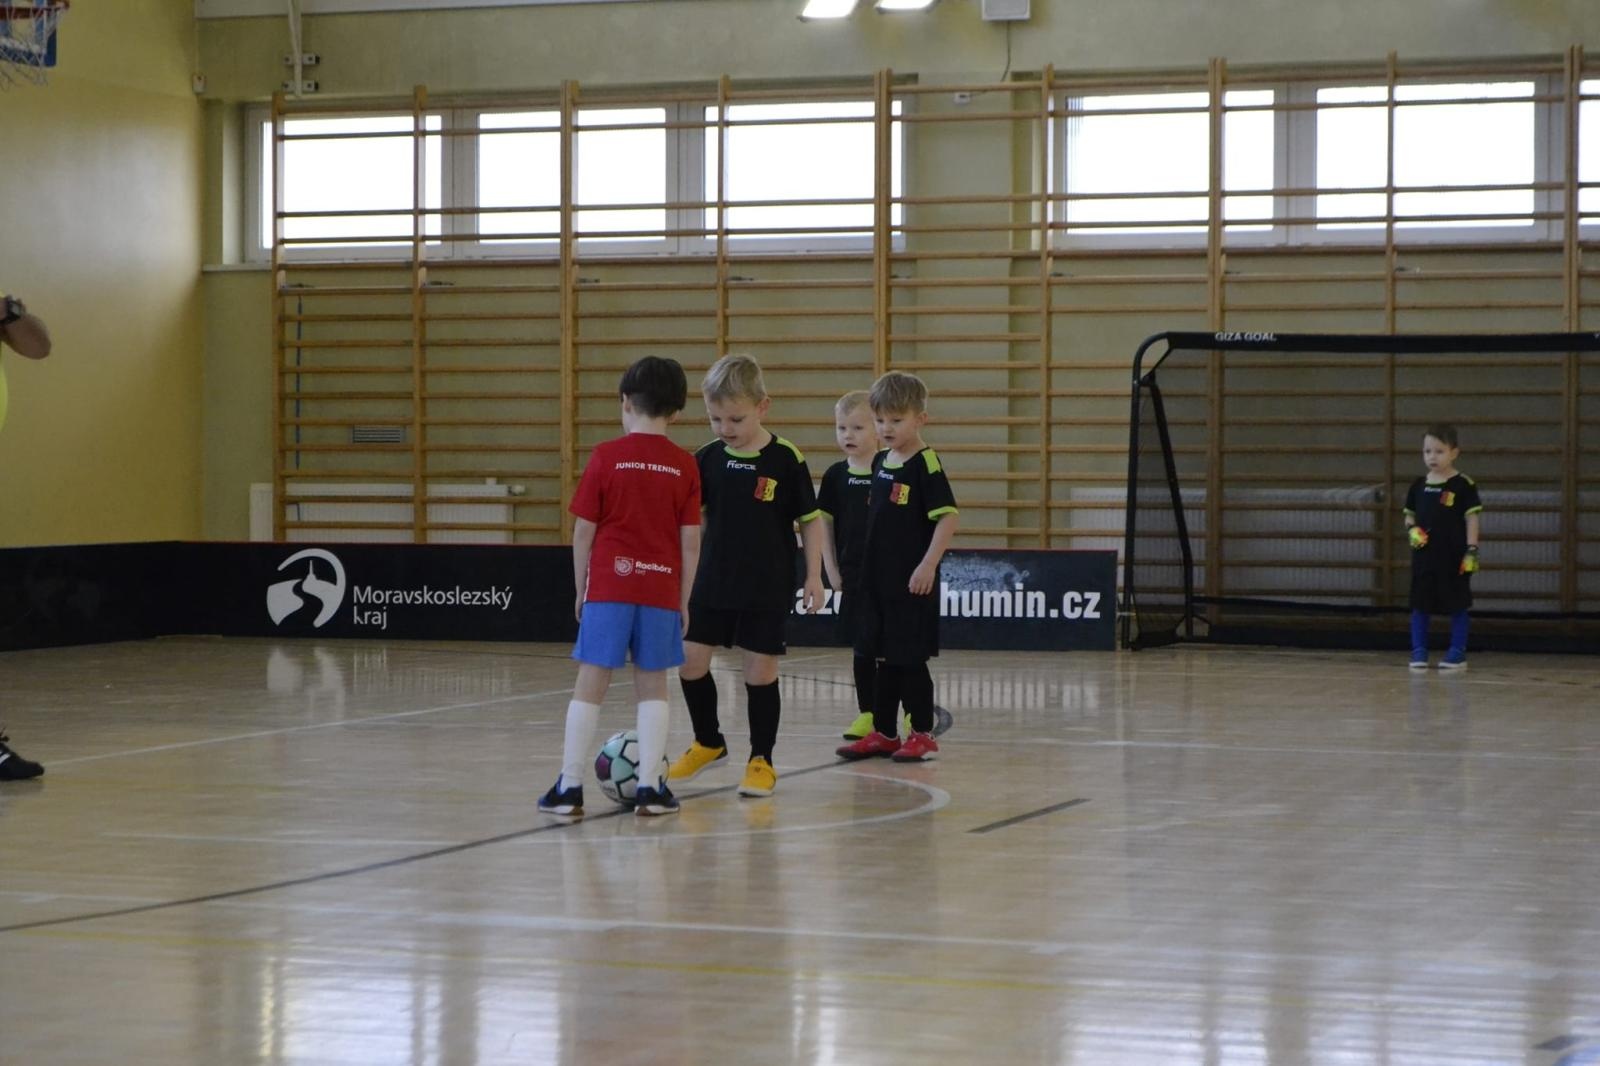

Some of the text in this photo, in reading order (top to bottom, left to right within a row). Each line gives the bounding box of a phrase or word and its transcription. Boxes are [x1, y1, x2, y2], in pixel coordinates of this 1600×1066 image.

[615, 461, 681, 476] JUNIOR TRENING
[353, 585, 513, 610] Moravskoslezský
[353, 606, 388, 630] kraj
